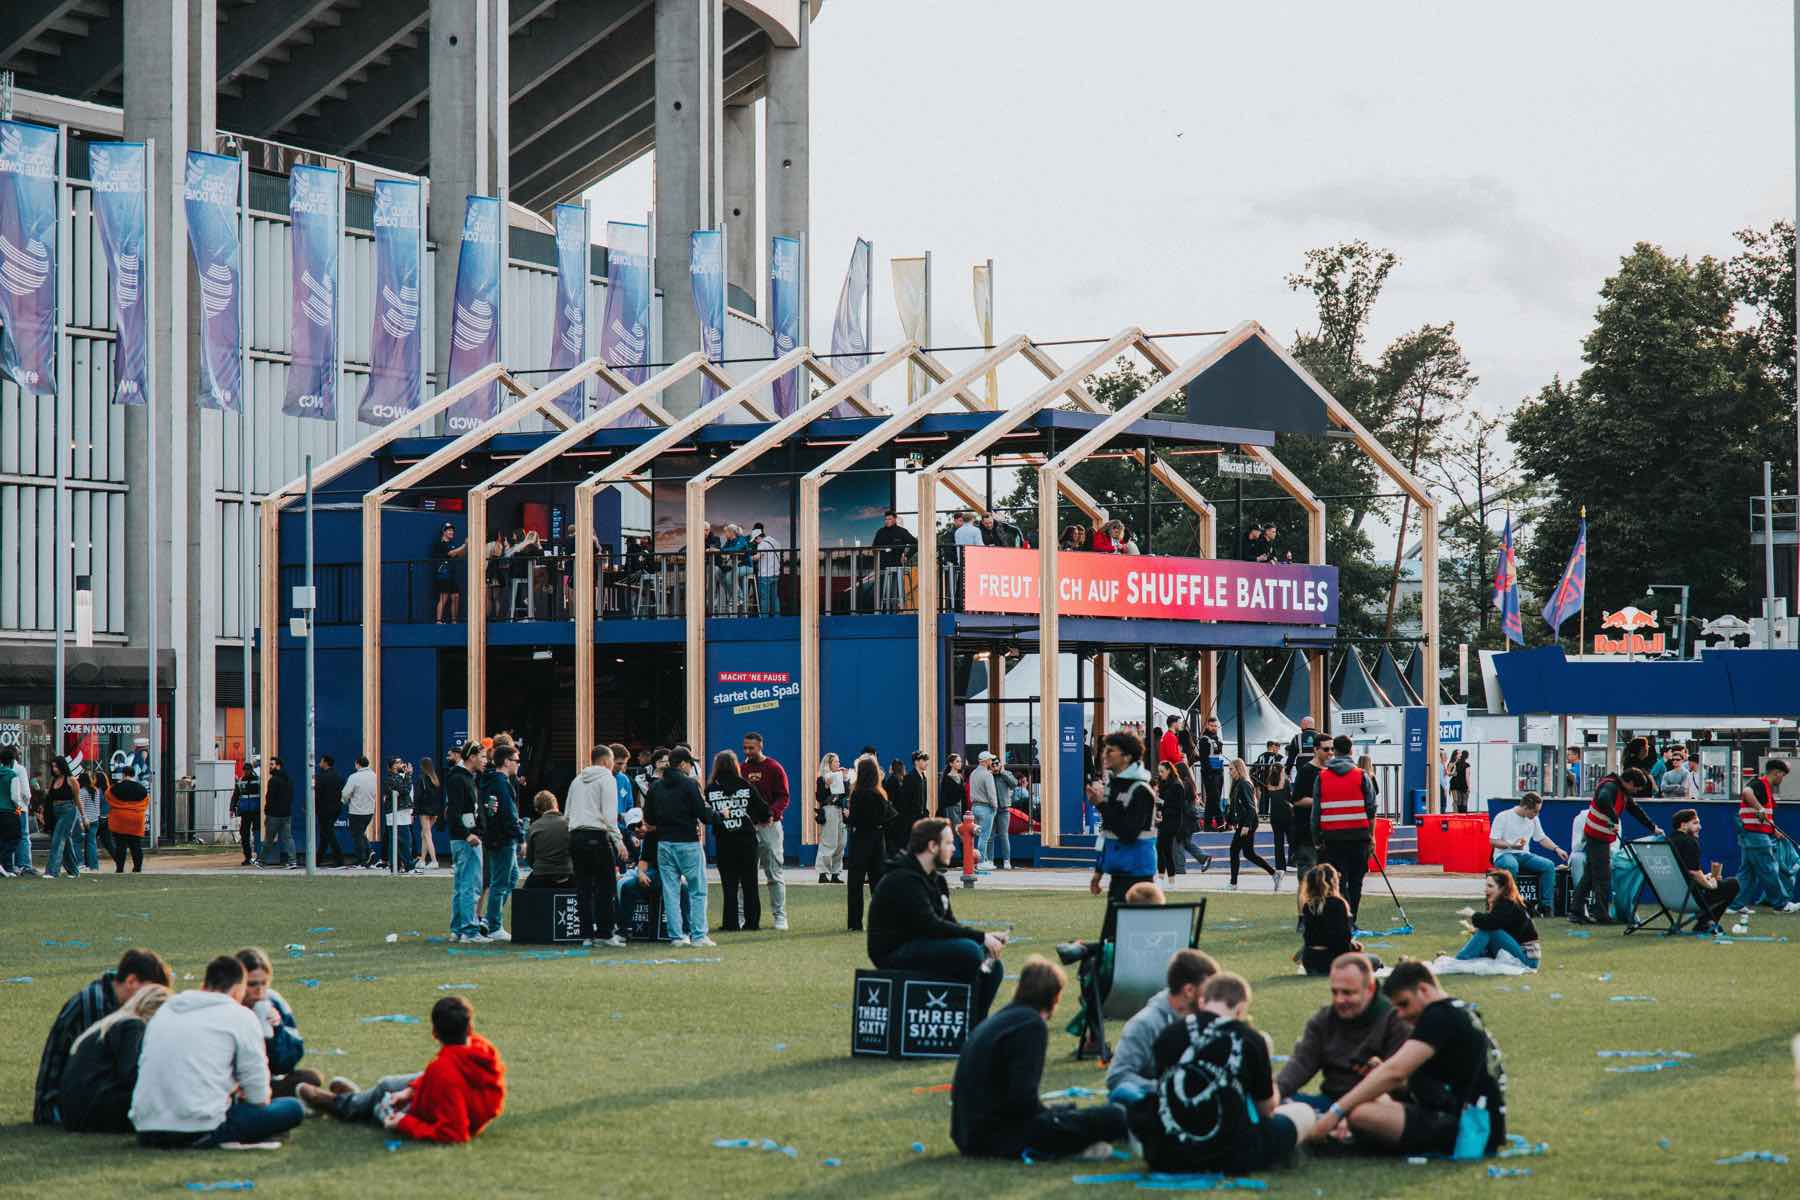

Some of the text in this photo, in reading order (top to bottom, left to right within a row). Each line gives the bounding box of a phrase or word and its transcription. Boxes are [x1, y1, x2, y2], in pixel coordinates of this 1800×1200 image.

[978, 575, 1033, 599] FREUT
[1088, 579, 1119, 603] AUF
[1126, 571, 1228, 607] SHUFFLE
[1237, 577, 1328, 612] BATTLES
[720, 673, 747, 681] MACHT
[763, 673, 787, 682] PAUSE
[713, 682, 800, 704] startet den Spaß
[1440, 724, 1461, 738] RENT
[0, 731, 20, 747] OX
[709, 788, 750, 801] BECUSE
[716, 799, 749, 810] WOULD
[723, 818, 742, 829] YOU
[858, 1006, 889, 1021] THREE
[907, 1009, 965, 1025] THREE
[858, 1021, 887, 1036] SIXTY
[910, 1024, 962, 1038] SIXTY
